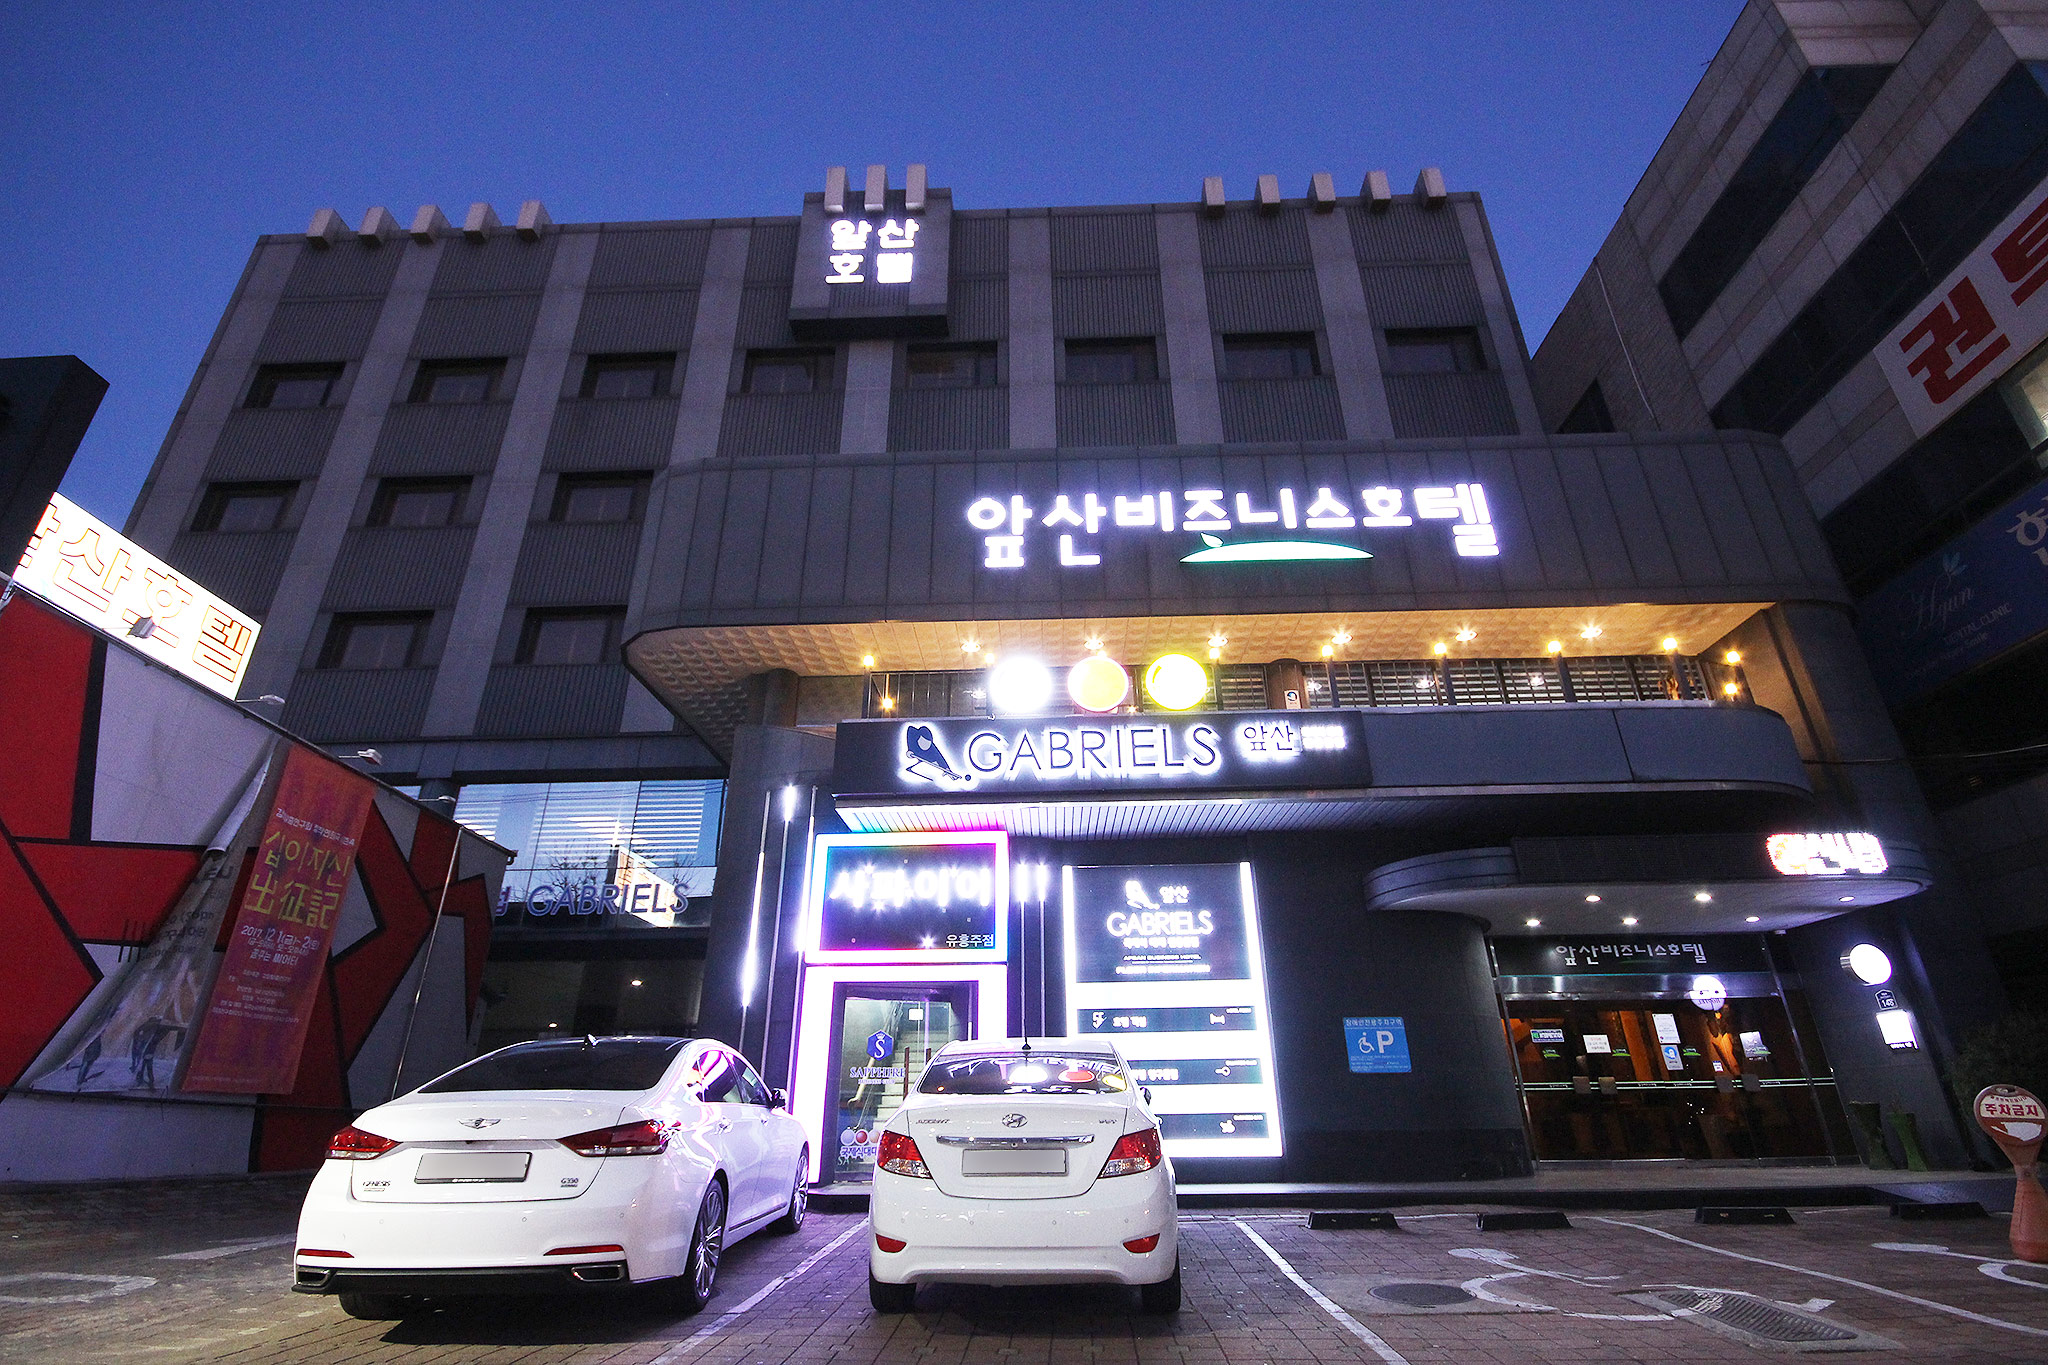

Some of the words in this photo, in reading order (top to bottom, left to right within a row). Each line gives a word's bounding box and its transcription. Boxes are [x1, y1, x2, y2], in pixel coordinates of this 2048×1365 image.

[825, 252, 914, 284] 호
[966, 483, 1501, 569] 앞산비즈니스호텔
[967, 725, 1219, 774] GABRIELS
[1244, 725, 1294, 752] 앞산
[264, 831, 351, 888] 십이지신
[244, 871, 339, 930] 出征記
[527, 883, 690, 917] GABRIELS
[1107, 910, 1214, 937] GABRIELS
[946, 934, 994, 948] 유흥주점
[1555, 943, 1707, 965] 앞산비즈니스호텔
[874, 1039, 886, 1059] S
[1376, 1031, 1394, 1053] P
[849, 1066, 906, 1078] SAPPHIRE
[1985, 1103, 2039, 1117] 주차금지
